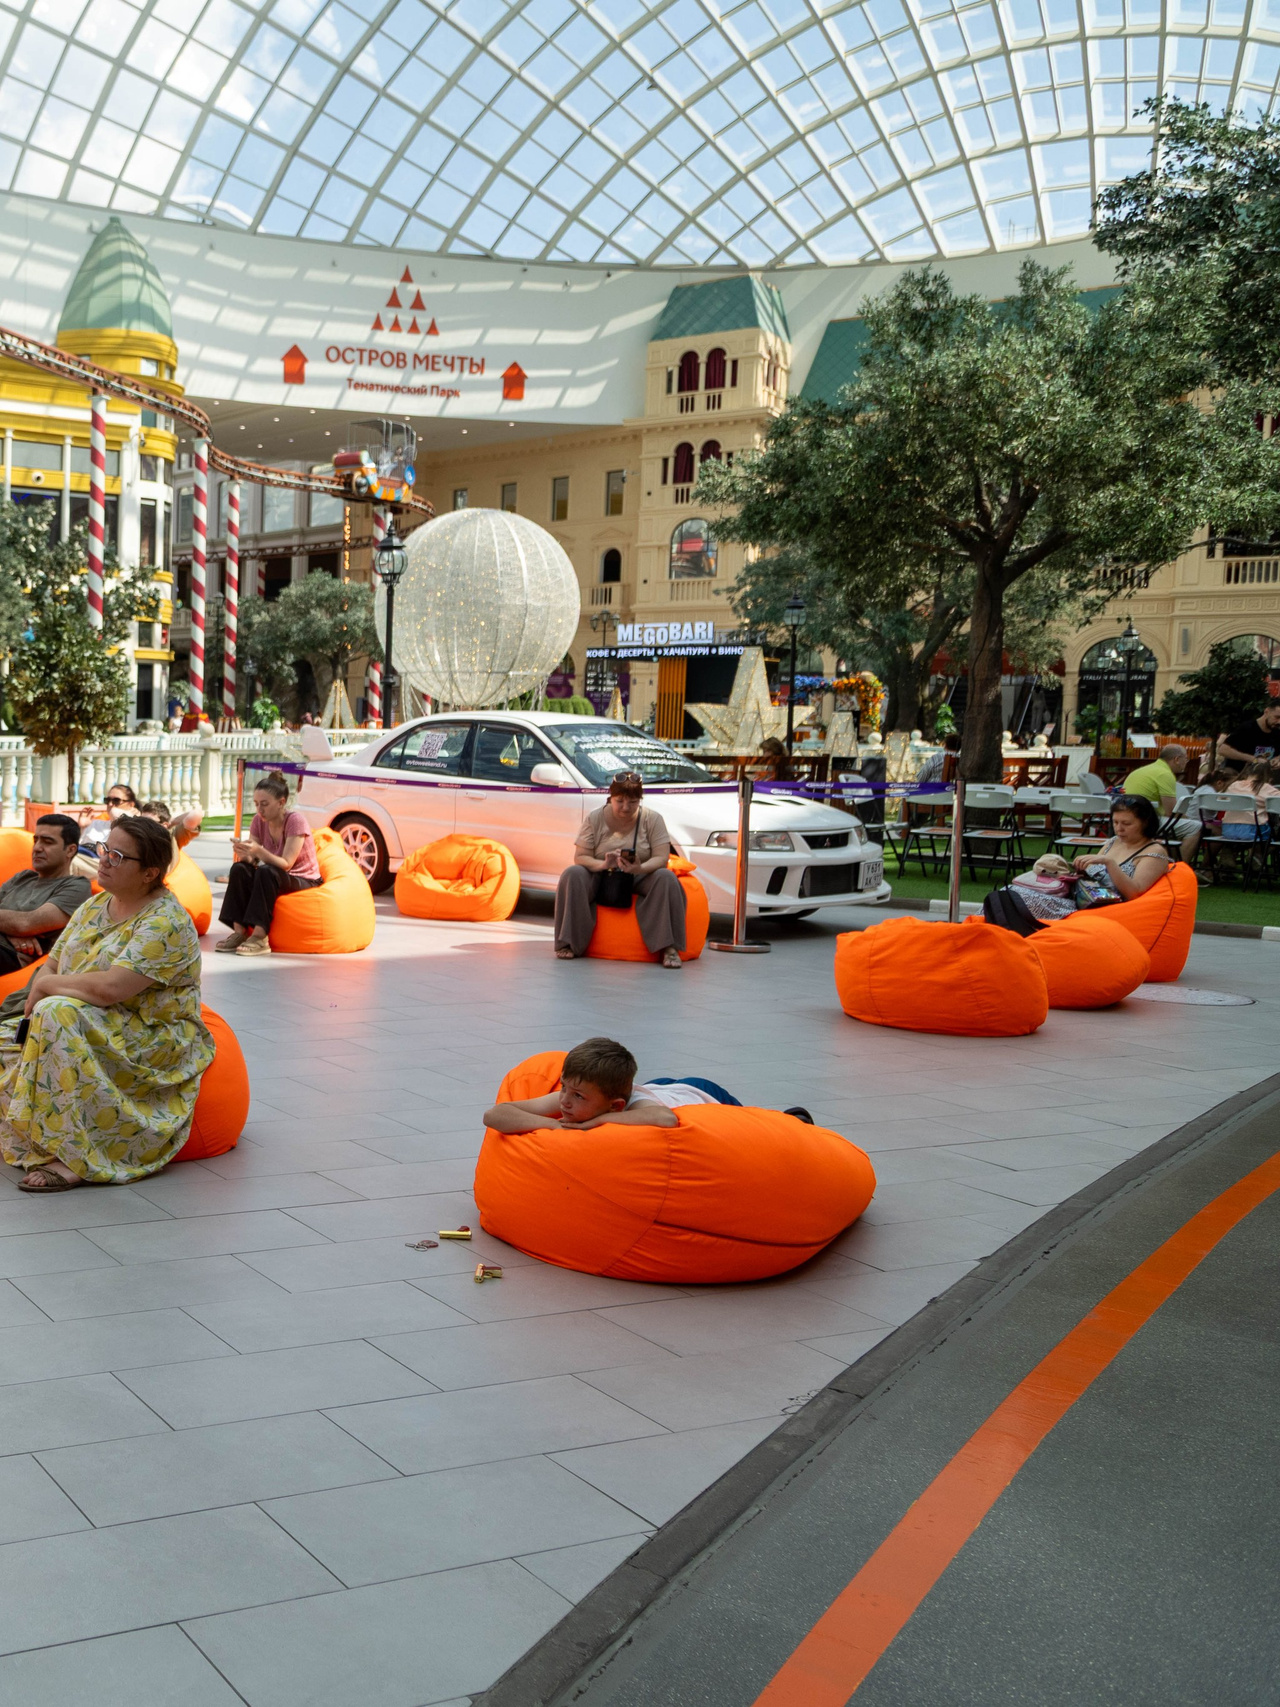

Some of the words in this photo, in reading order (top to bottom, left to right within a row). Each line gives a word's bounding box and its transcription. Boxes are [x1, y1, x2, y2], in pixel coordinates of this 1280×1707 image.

[325, 345, 407, 369] ОСТРОВ
[412, 353, 485, 375] МЕЧТЫ
[346, 378, 428, 397] Тематический
[430, 385, 461, 399] Парк
[617, 621, 714, 645] MEGOBARI
[586, 649, 610, 658] КОФЕ
[617, 648, 655, 658] ДЕСЕРТЫ
[663, 647, 709, 656] ХАЧАПУРИ
[718, 646, 744, 655] ВИНО
[405, 760, 448, 768] avtoweekend.ru
